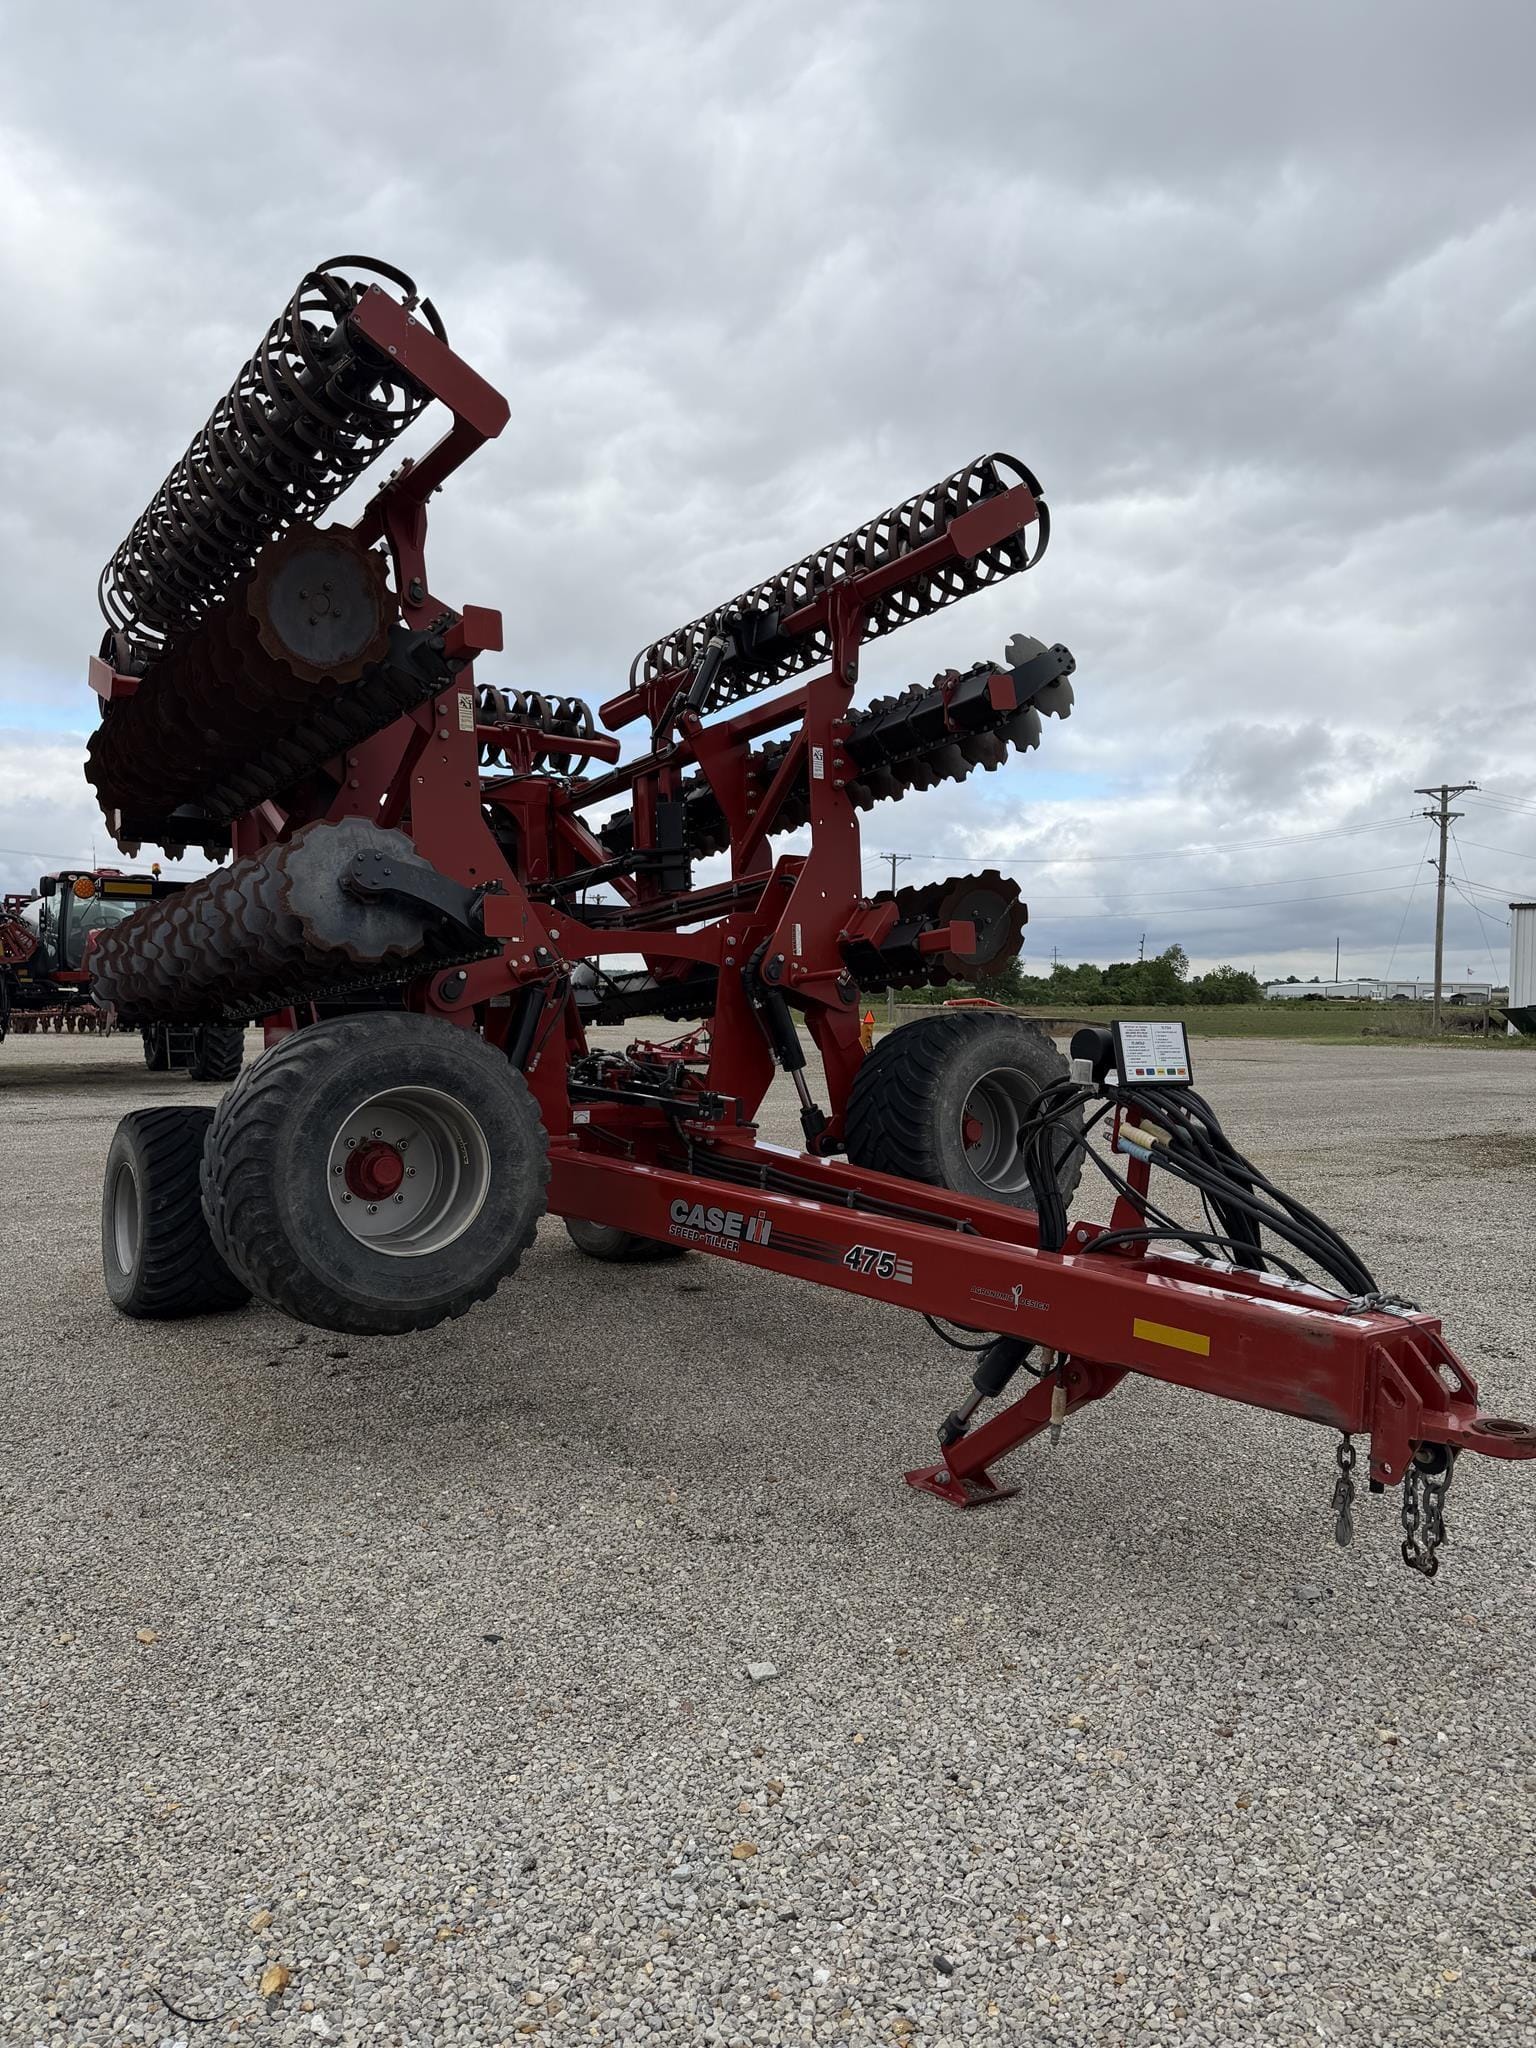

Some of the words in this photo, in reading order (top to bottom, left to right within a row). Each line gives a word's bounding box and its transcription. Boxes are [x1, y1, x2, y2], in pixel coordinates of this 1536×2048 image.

[670, 1199, 744, 1238] CASE
[843, 1244, 897, 1280] 475
[1019, 1297, 1050, 1312] DESIGN
